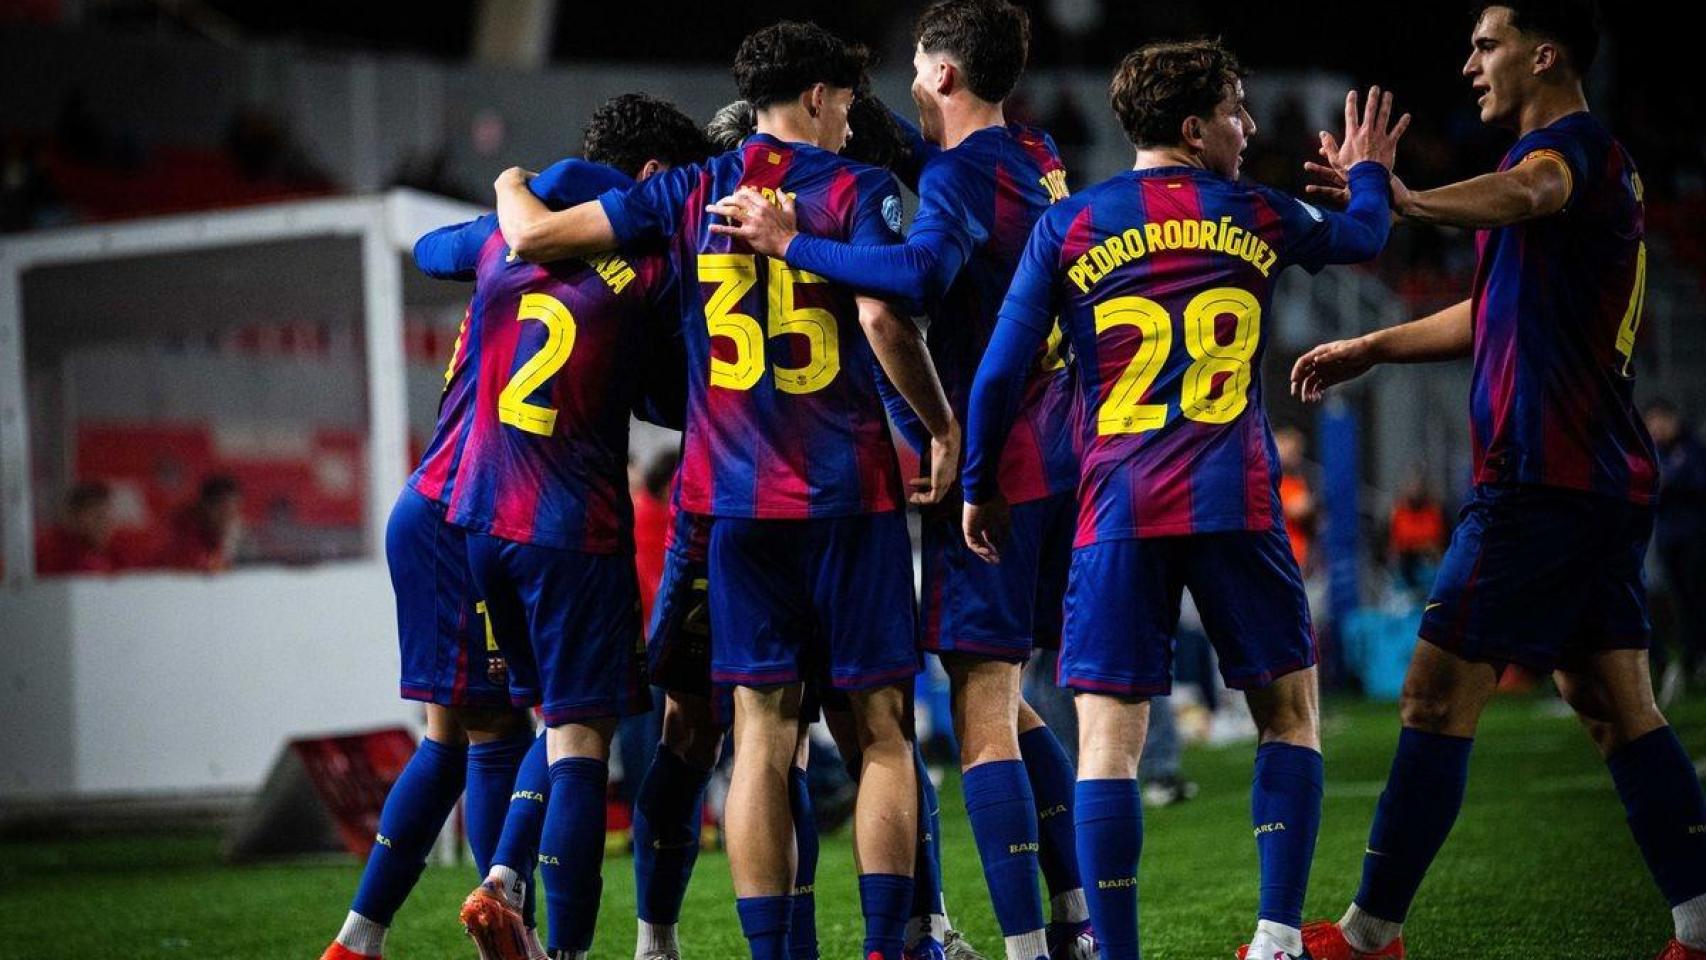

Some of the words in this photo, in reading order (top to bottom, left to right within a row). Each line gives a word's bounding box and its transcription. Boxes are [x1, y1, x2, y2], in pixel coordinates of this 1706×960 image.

[698, 253, 841, 395] 35
[1067, 228, 1146, 294] PEDRO
[1144, 215, 1278, 278] RODRÍGUEZ
[498, 292, 577, 437] 2
[1093, 286, 1262, 436] 28
